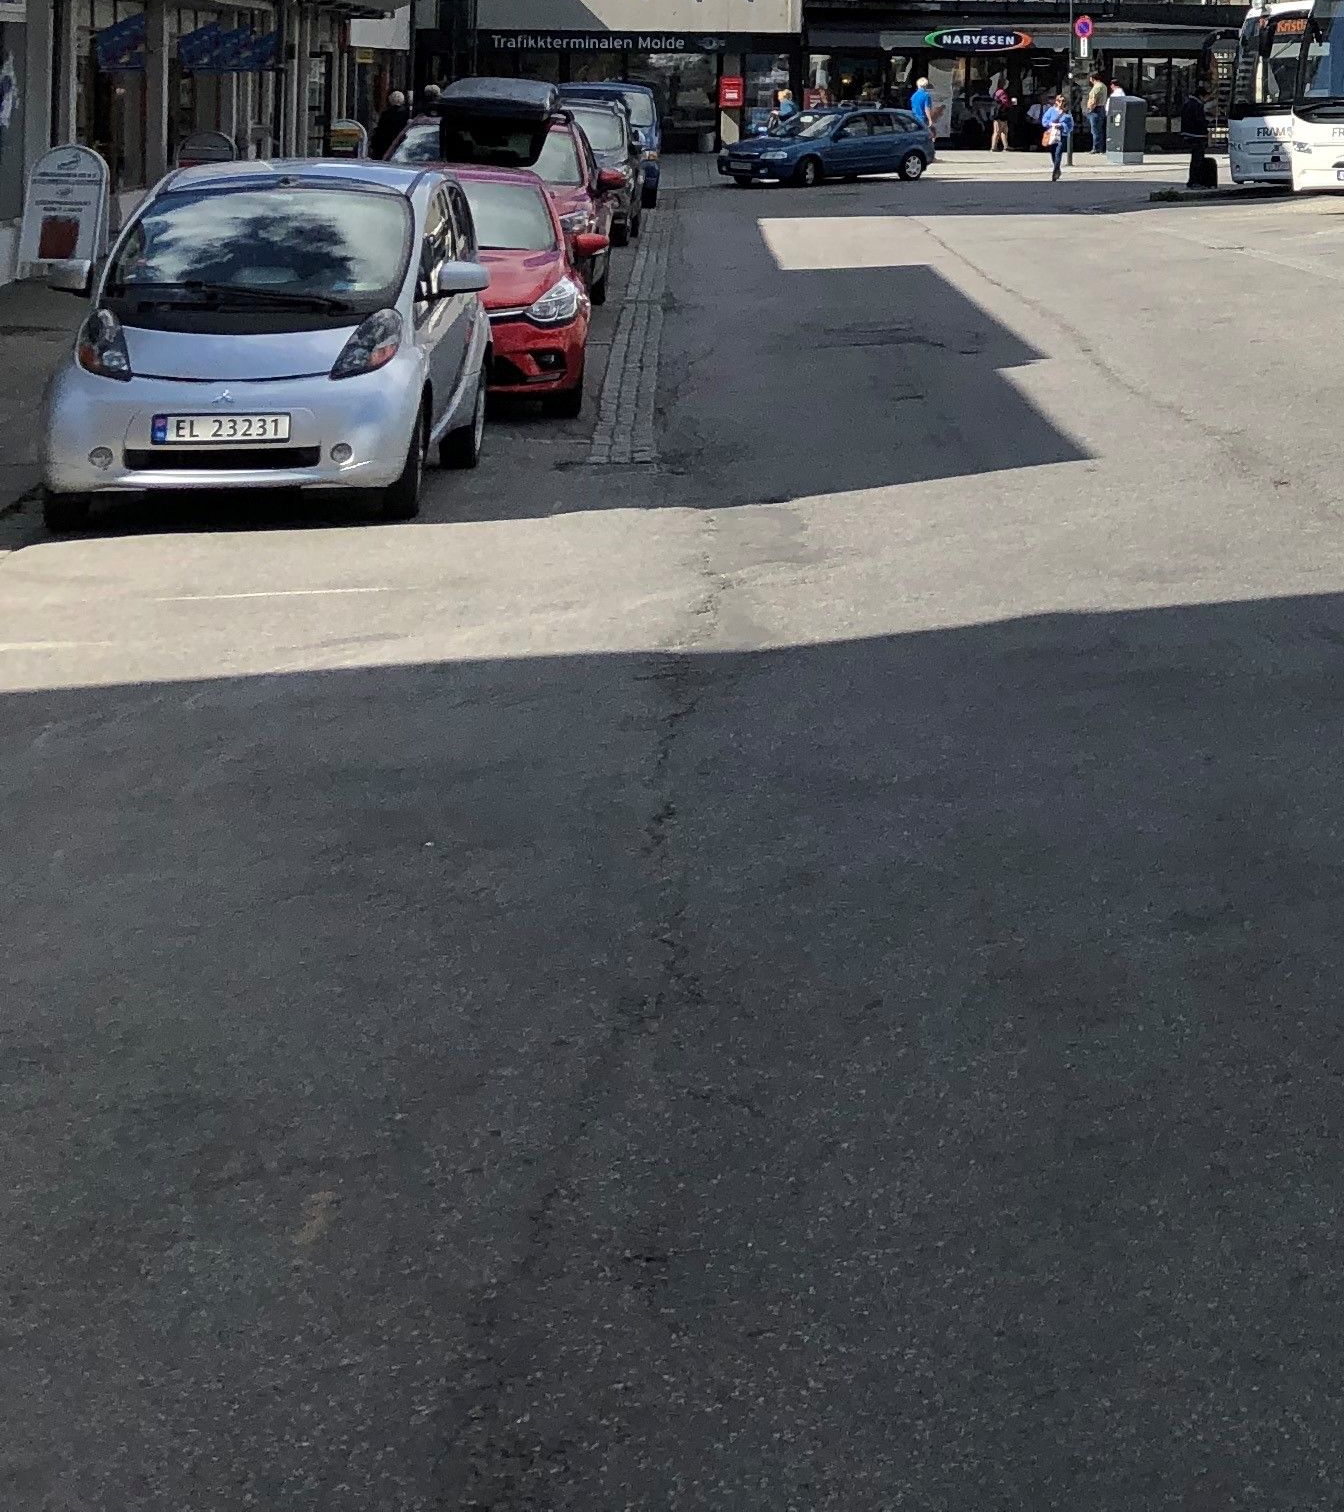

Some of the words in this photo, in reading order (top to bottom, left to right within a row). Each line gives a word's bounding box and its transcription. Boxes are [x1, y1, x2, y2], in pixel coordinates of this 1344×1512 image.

[491, 35, 633, 49] Trafikkterminalen
[638, 36, 685, 49] Molde
[942, 35, 1015, 45] NARVESEN
[1256, 127, 1286, 137] FRAM
[175, 419, 200, 438] EL
[211, 418, 279, 438] 23231
